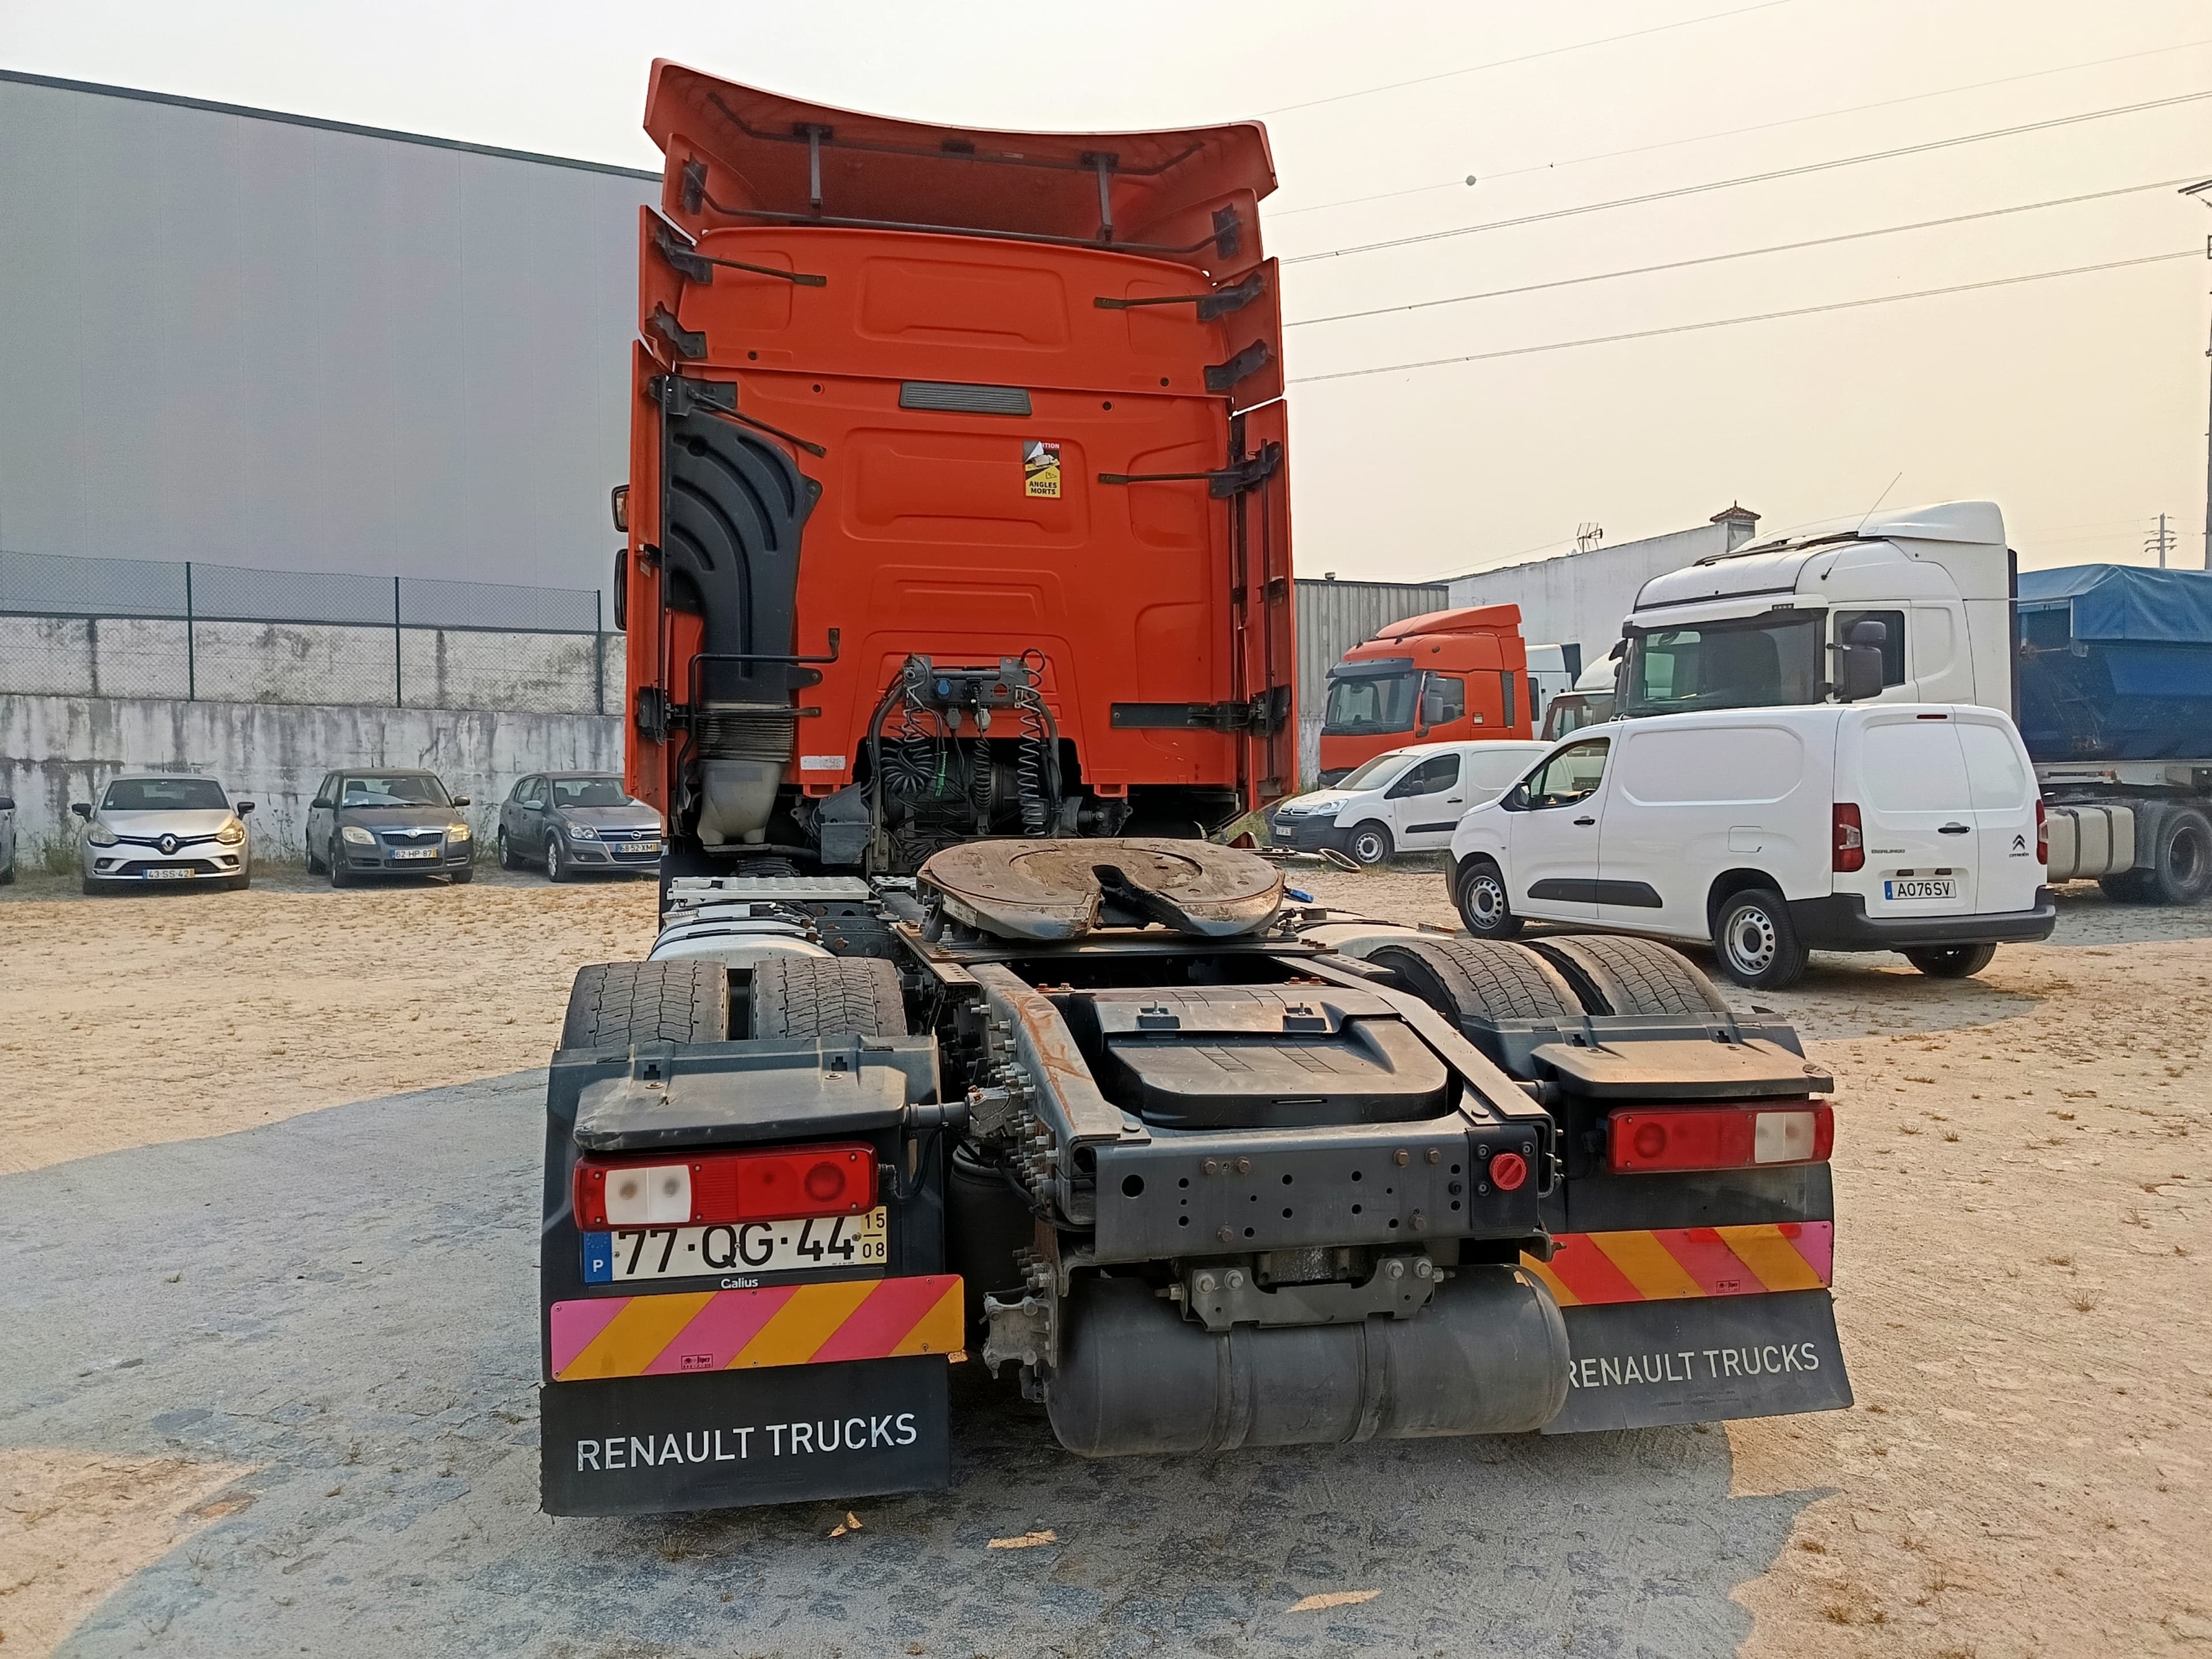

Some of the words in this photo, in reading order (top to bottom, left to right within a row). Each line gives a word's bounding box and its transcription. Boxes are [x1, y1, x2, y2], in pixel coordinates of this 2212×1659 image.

[865, 1213, 885, 1229] 15
[863, 1243, 884, 1258] 08
[593, 1260, 603, 1272] P
[721, 1277, 759, 1289] Galius
[1569, 1352, 1695, 1388] RENAULT
[1703, 1343, 1819, 1377] TRUCKS
[578, 1427, 755, 1472] RENAULT
[766, 1413, 917, 1456] TRUCKS
